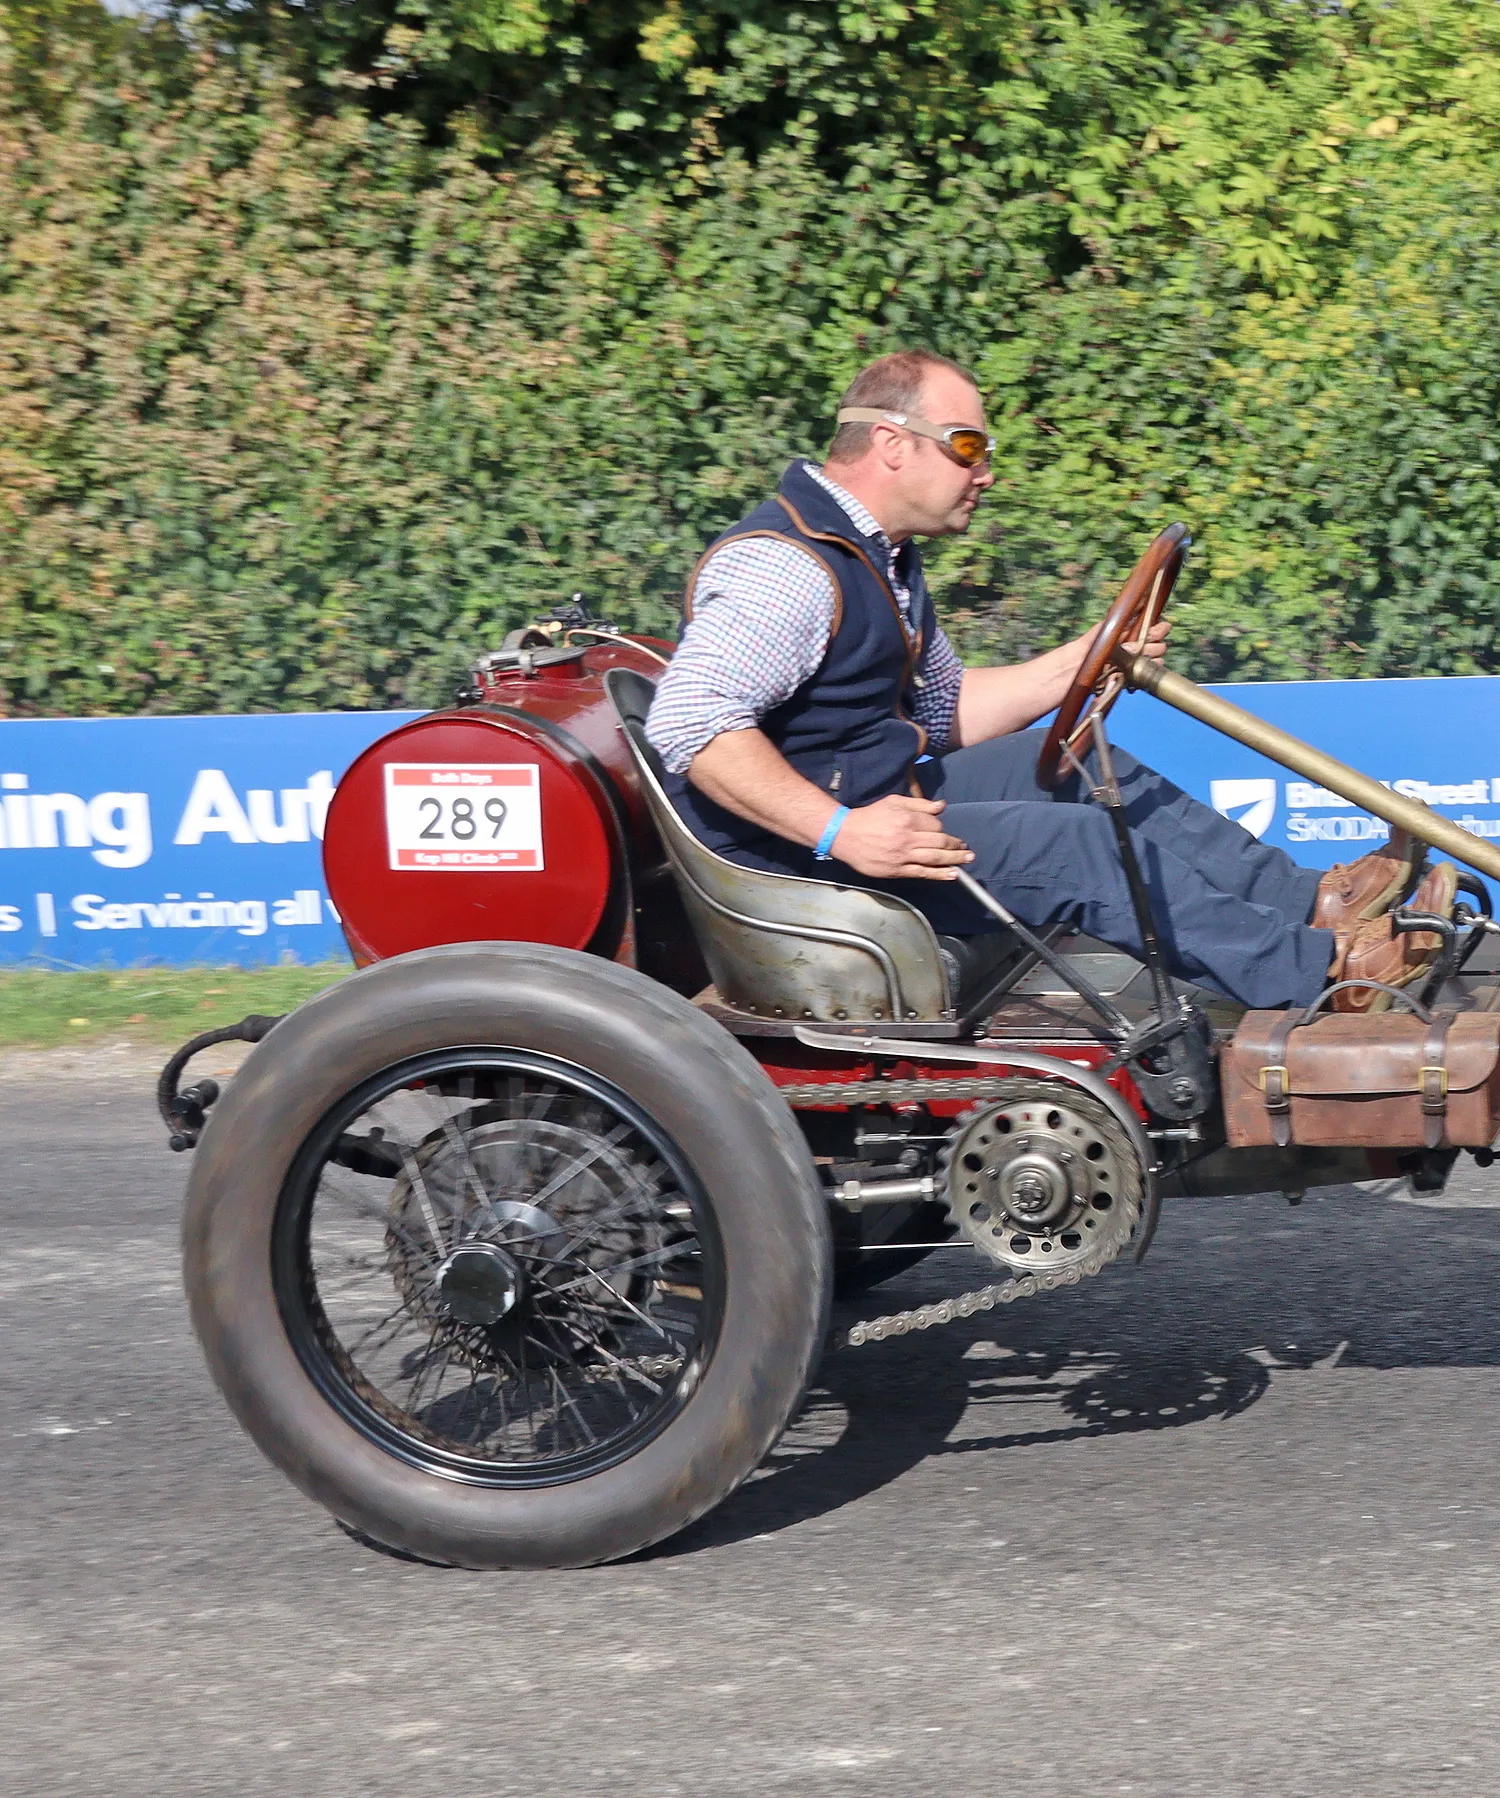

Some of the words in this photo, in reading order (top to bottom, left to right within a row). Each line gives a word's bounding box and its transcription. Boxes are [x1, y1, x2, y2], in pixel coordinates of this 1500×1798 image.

[460, 772, 493, 786] Days
[1392, 779, 1490, 805] Street
[0, 773, 153, 868] ing
[418, 797, 508, 840] 289
[1286, 812, 1391, 842] ŠKODA
[461, 852, 500, 865] Climb
[71, 893, 269, 936] Servicing
[272, 890, 323, 926] all
